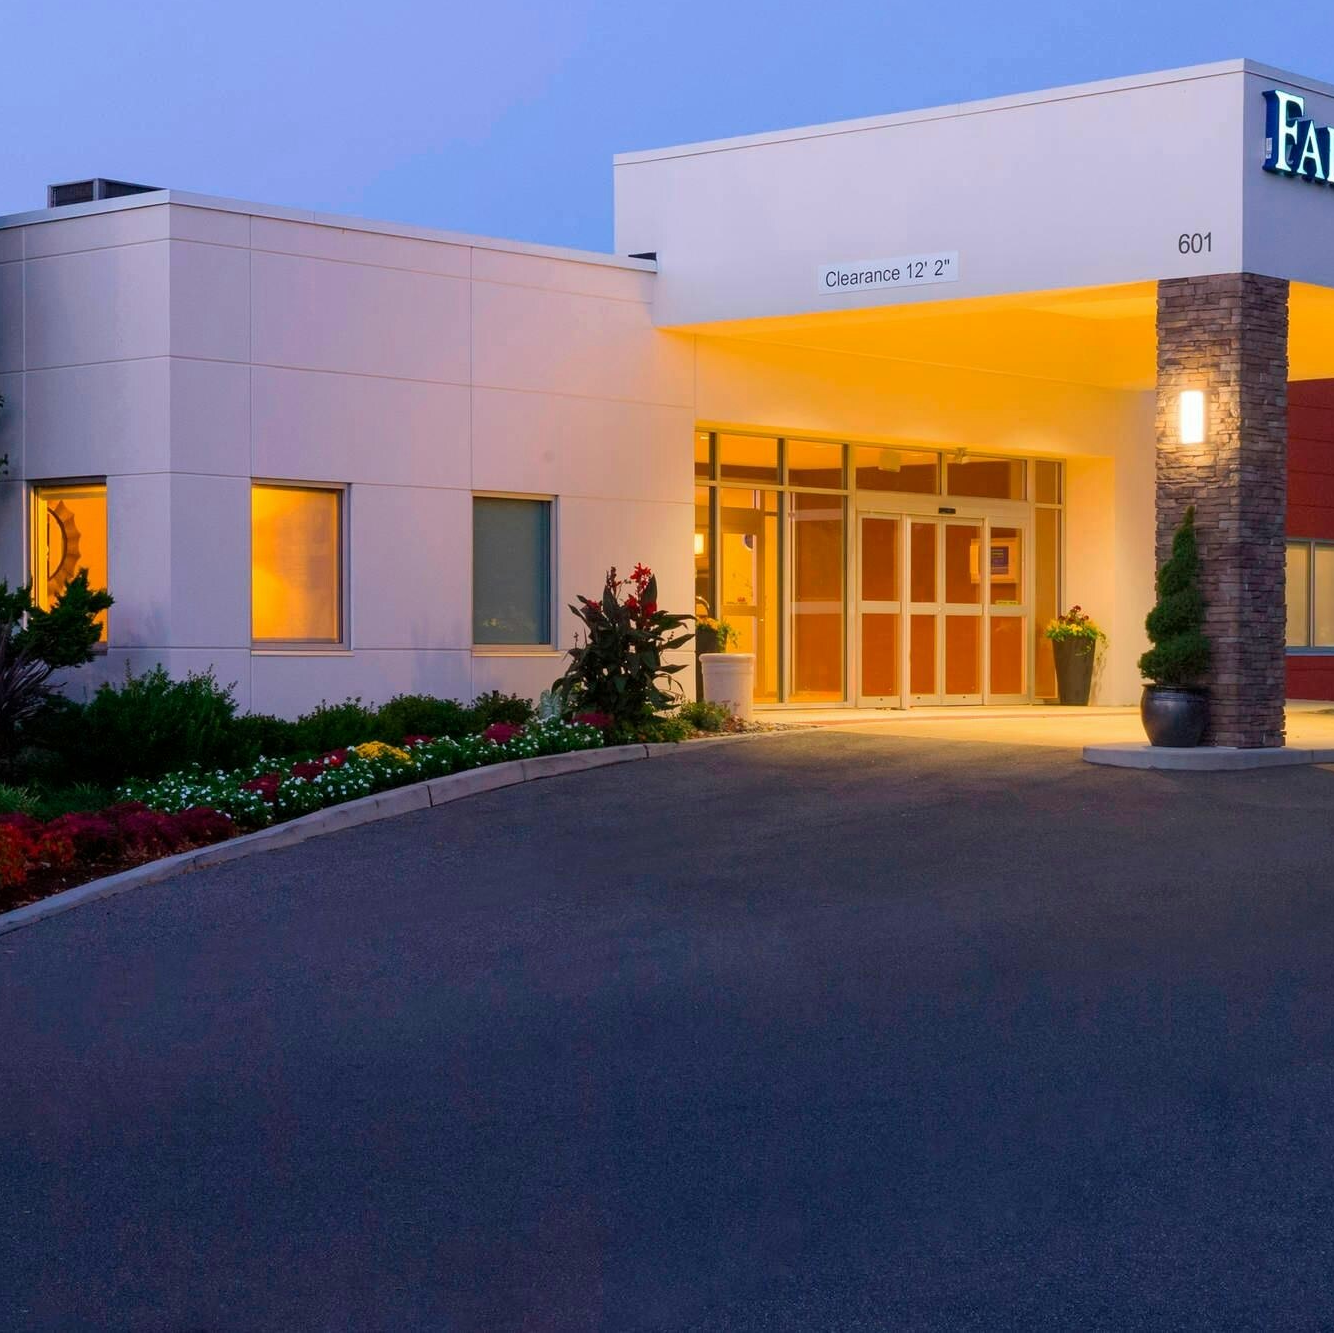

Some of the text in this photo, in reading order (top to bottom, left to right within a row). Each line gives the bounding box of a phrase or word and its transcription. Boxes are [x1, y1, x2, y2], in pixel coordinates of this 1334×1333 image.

[1178, 232, 1212, 254] 601
[825, 259, 950, 287] Clearance 12' 2"
